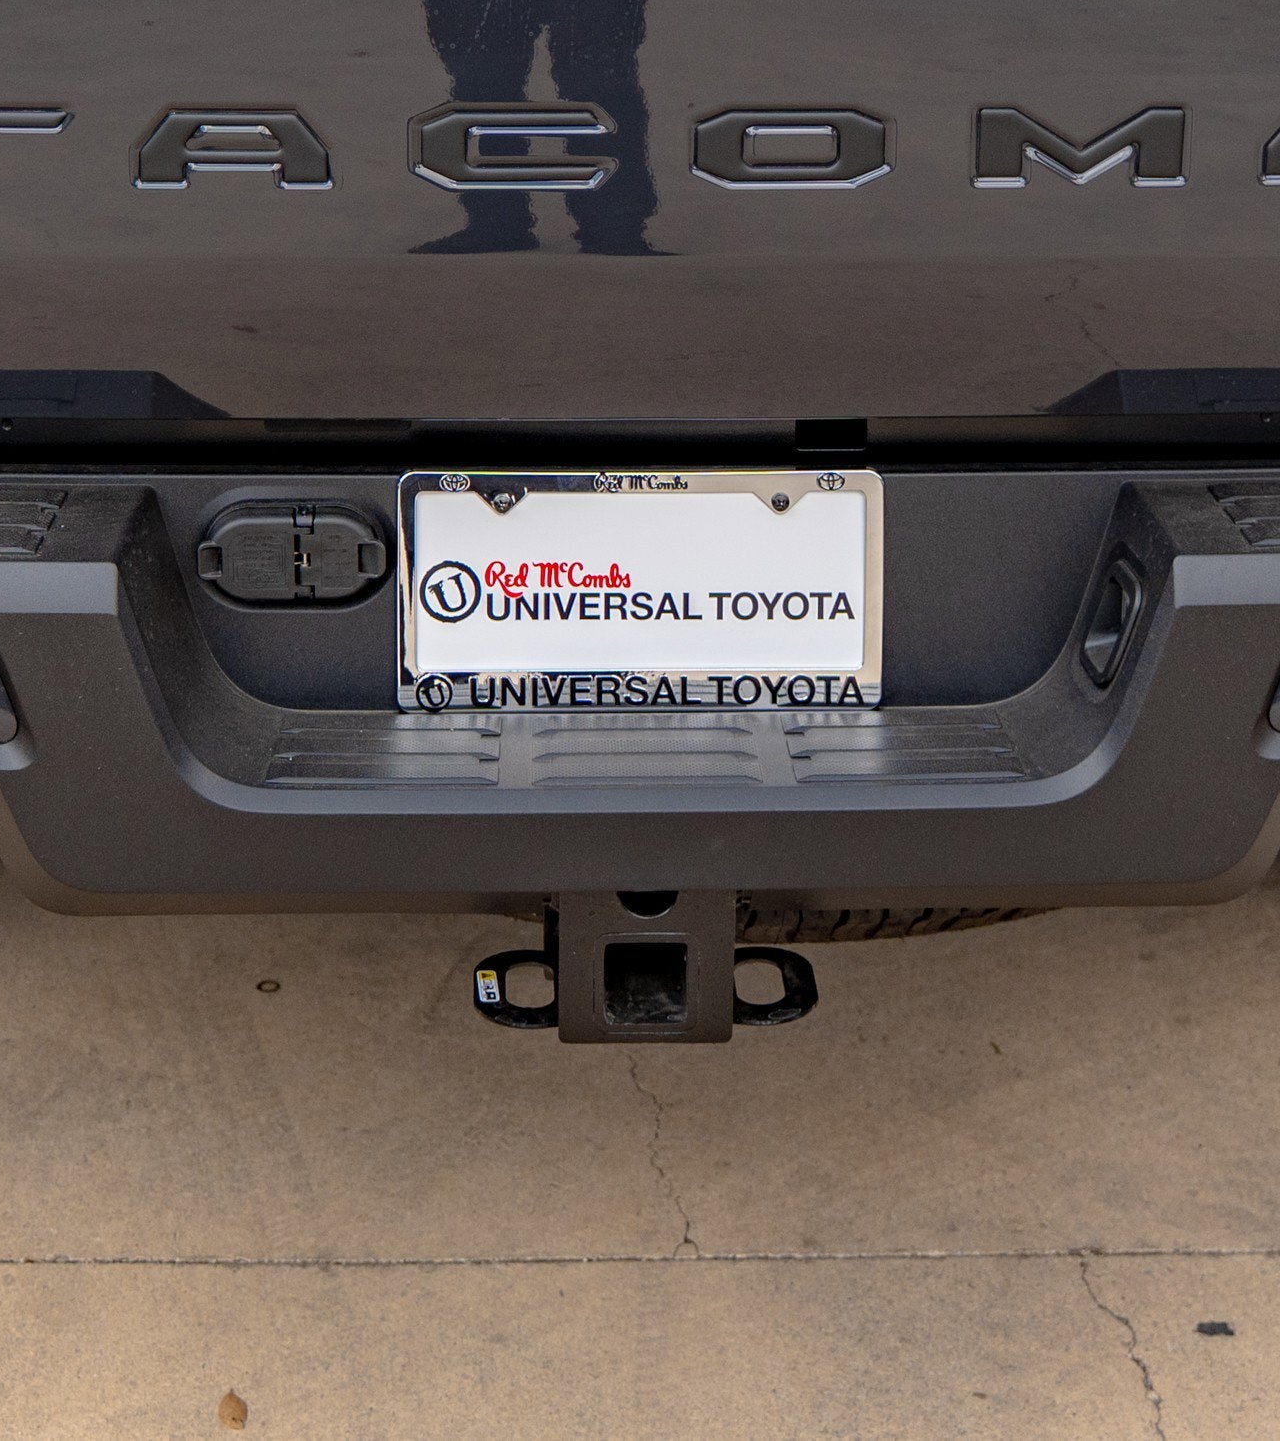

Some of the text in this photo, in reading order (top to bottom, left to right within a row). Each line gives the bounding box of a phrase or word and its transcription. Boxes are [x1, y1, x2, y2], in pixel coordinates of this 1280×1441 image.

[623, 474, 688, 490] McCombs
[484, 561, 631, 598] Red McCombs
[486, 592, 855, 621] UNIVERSAL TOYOTA
[470, 675, 701, 707] UNIVERSAL
[708, 675, 864, 706] TOYOTA
